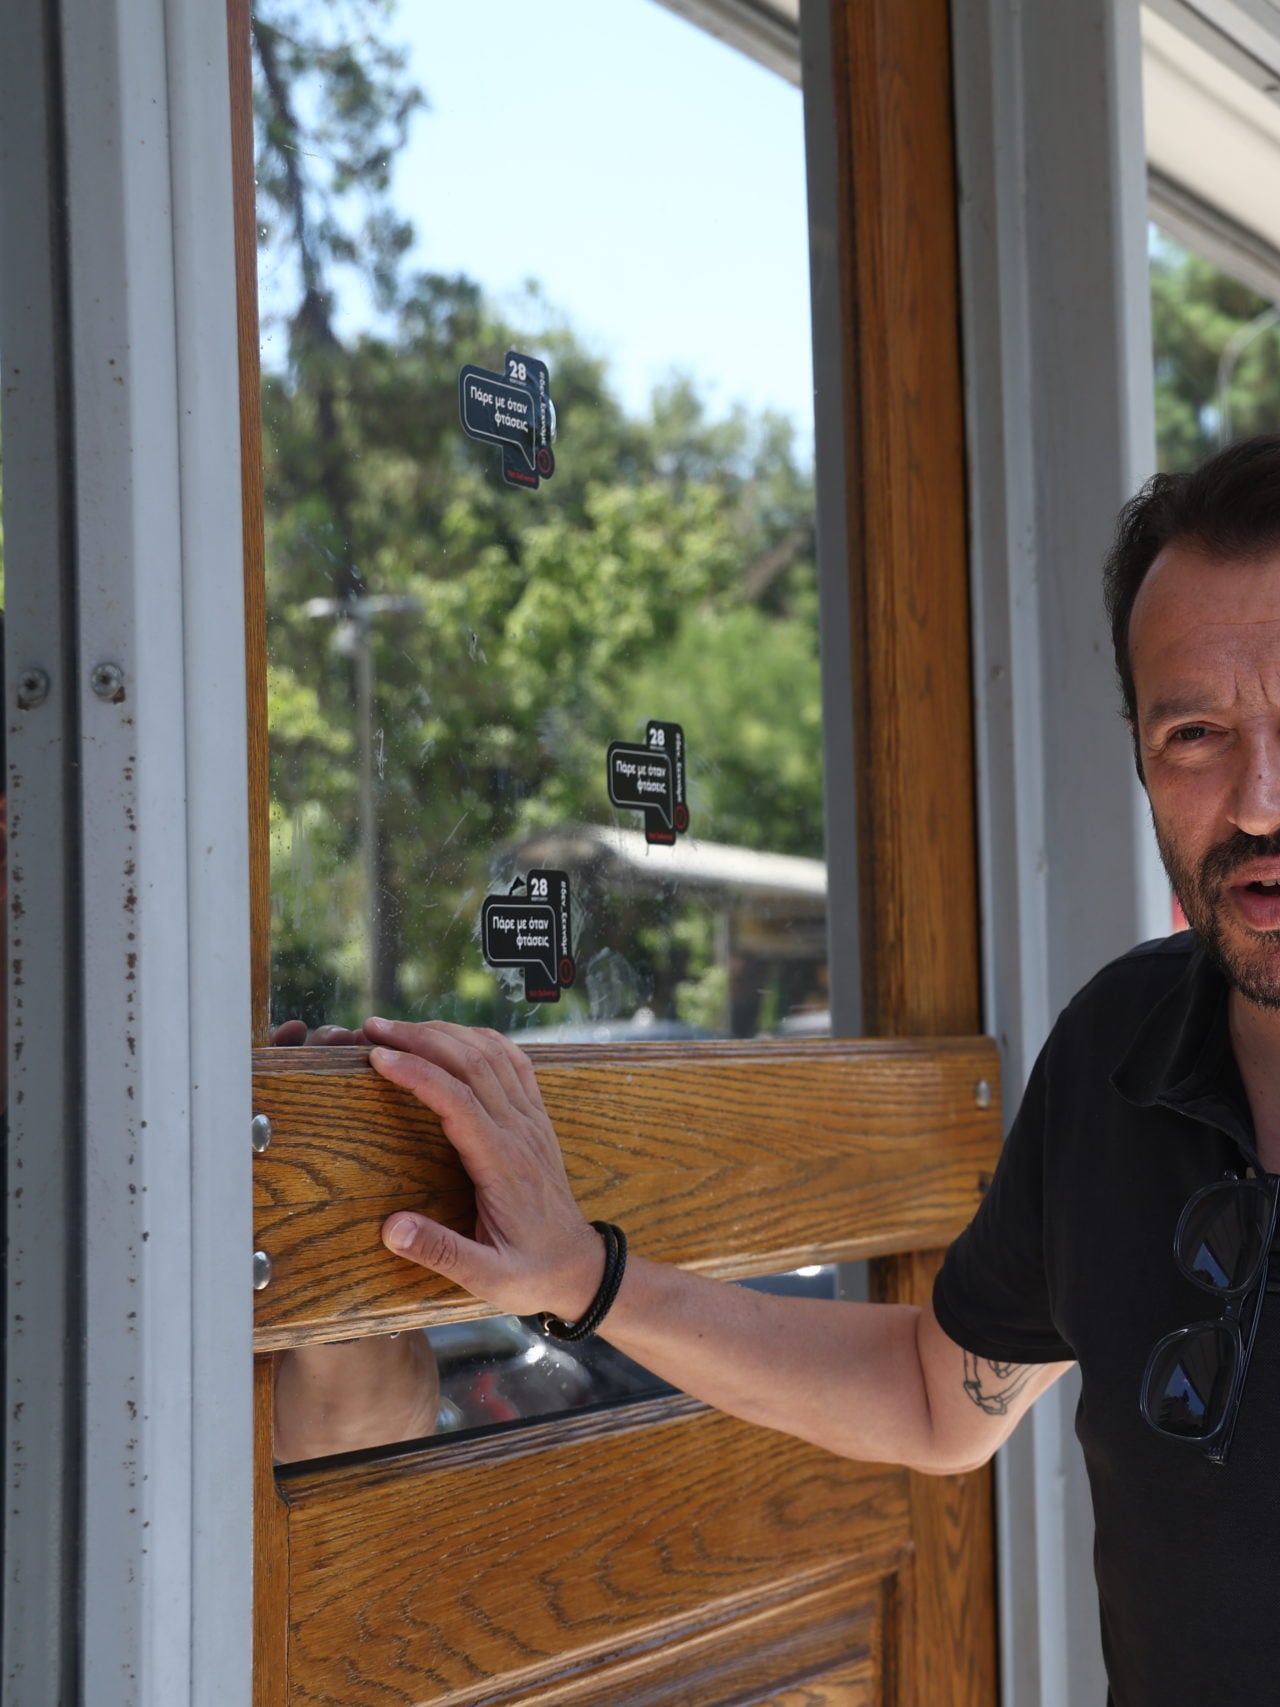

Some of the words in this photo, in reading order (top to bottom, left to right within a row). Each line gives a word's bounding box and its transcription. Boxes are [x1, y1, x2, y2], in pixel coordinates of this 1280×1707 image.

[509, 359, 527, 381] 28
[470, 386, 494, 406] Πάρε
[495, 396, 506, 411] με
[507, 397, 528, 414] όταν
[494, 411, 529, 432] φτάσεις
[649, 728, 665, 746] 28
[530, 878, 548, 896] 28
[492, 916, 514, 933] Πάρε
[516, 919, 527, 933] με
[528, 916, 549, 930] όταν
[516, 933, 549, 950] φτάσεις
